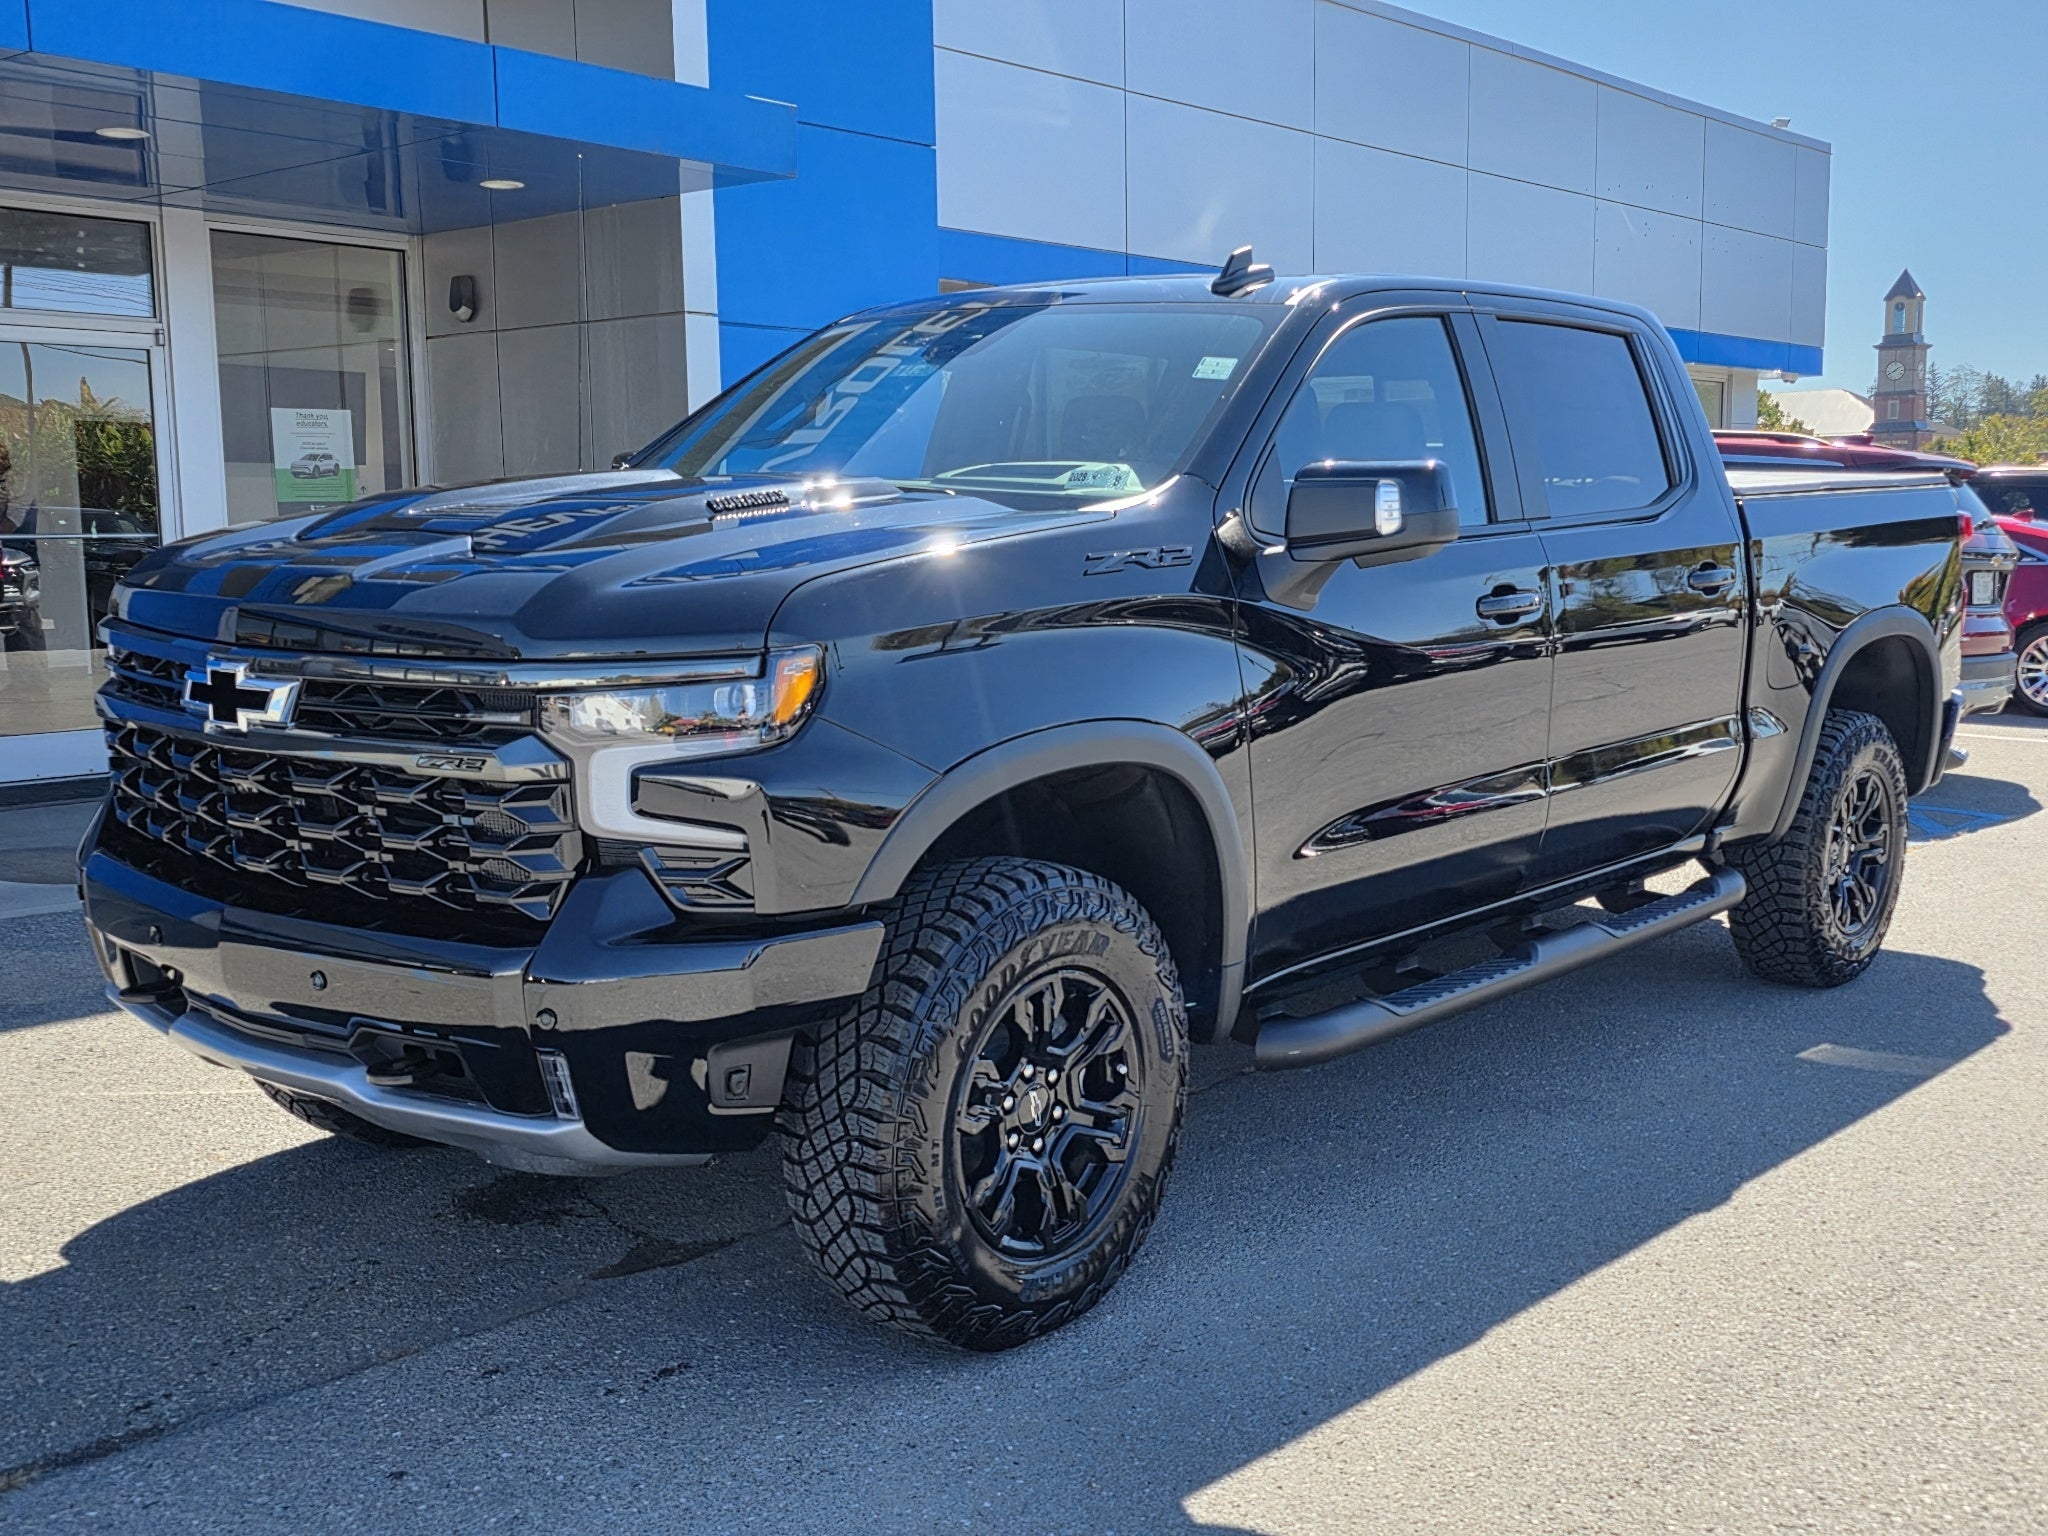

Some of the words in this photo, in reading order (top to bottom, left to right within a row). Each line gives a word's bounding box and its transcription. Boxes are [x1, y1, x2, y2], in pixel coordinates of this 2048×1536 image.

[1083, 544, 1193, 577] ZR2
[416, 753, 487, 772] ZR2
[955, 929, 1111, 1061] GOODYEAR
